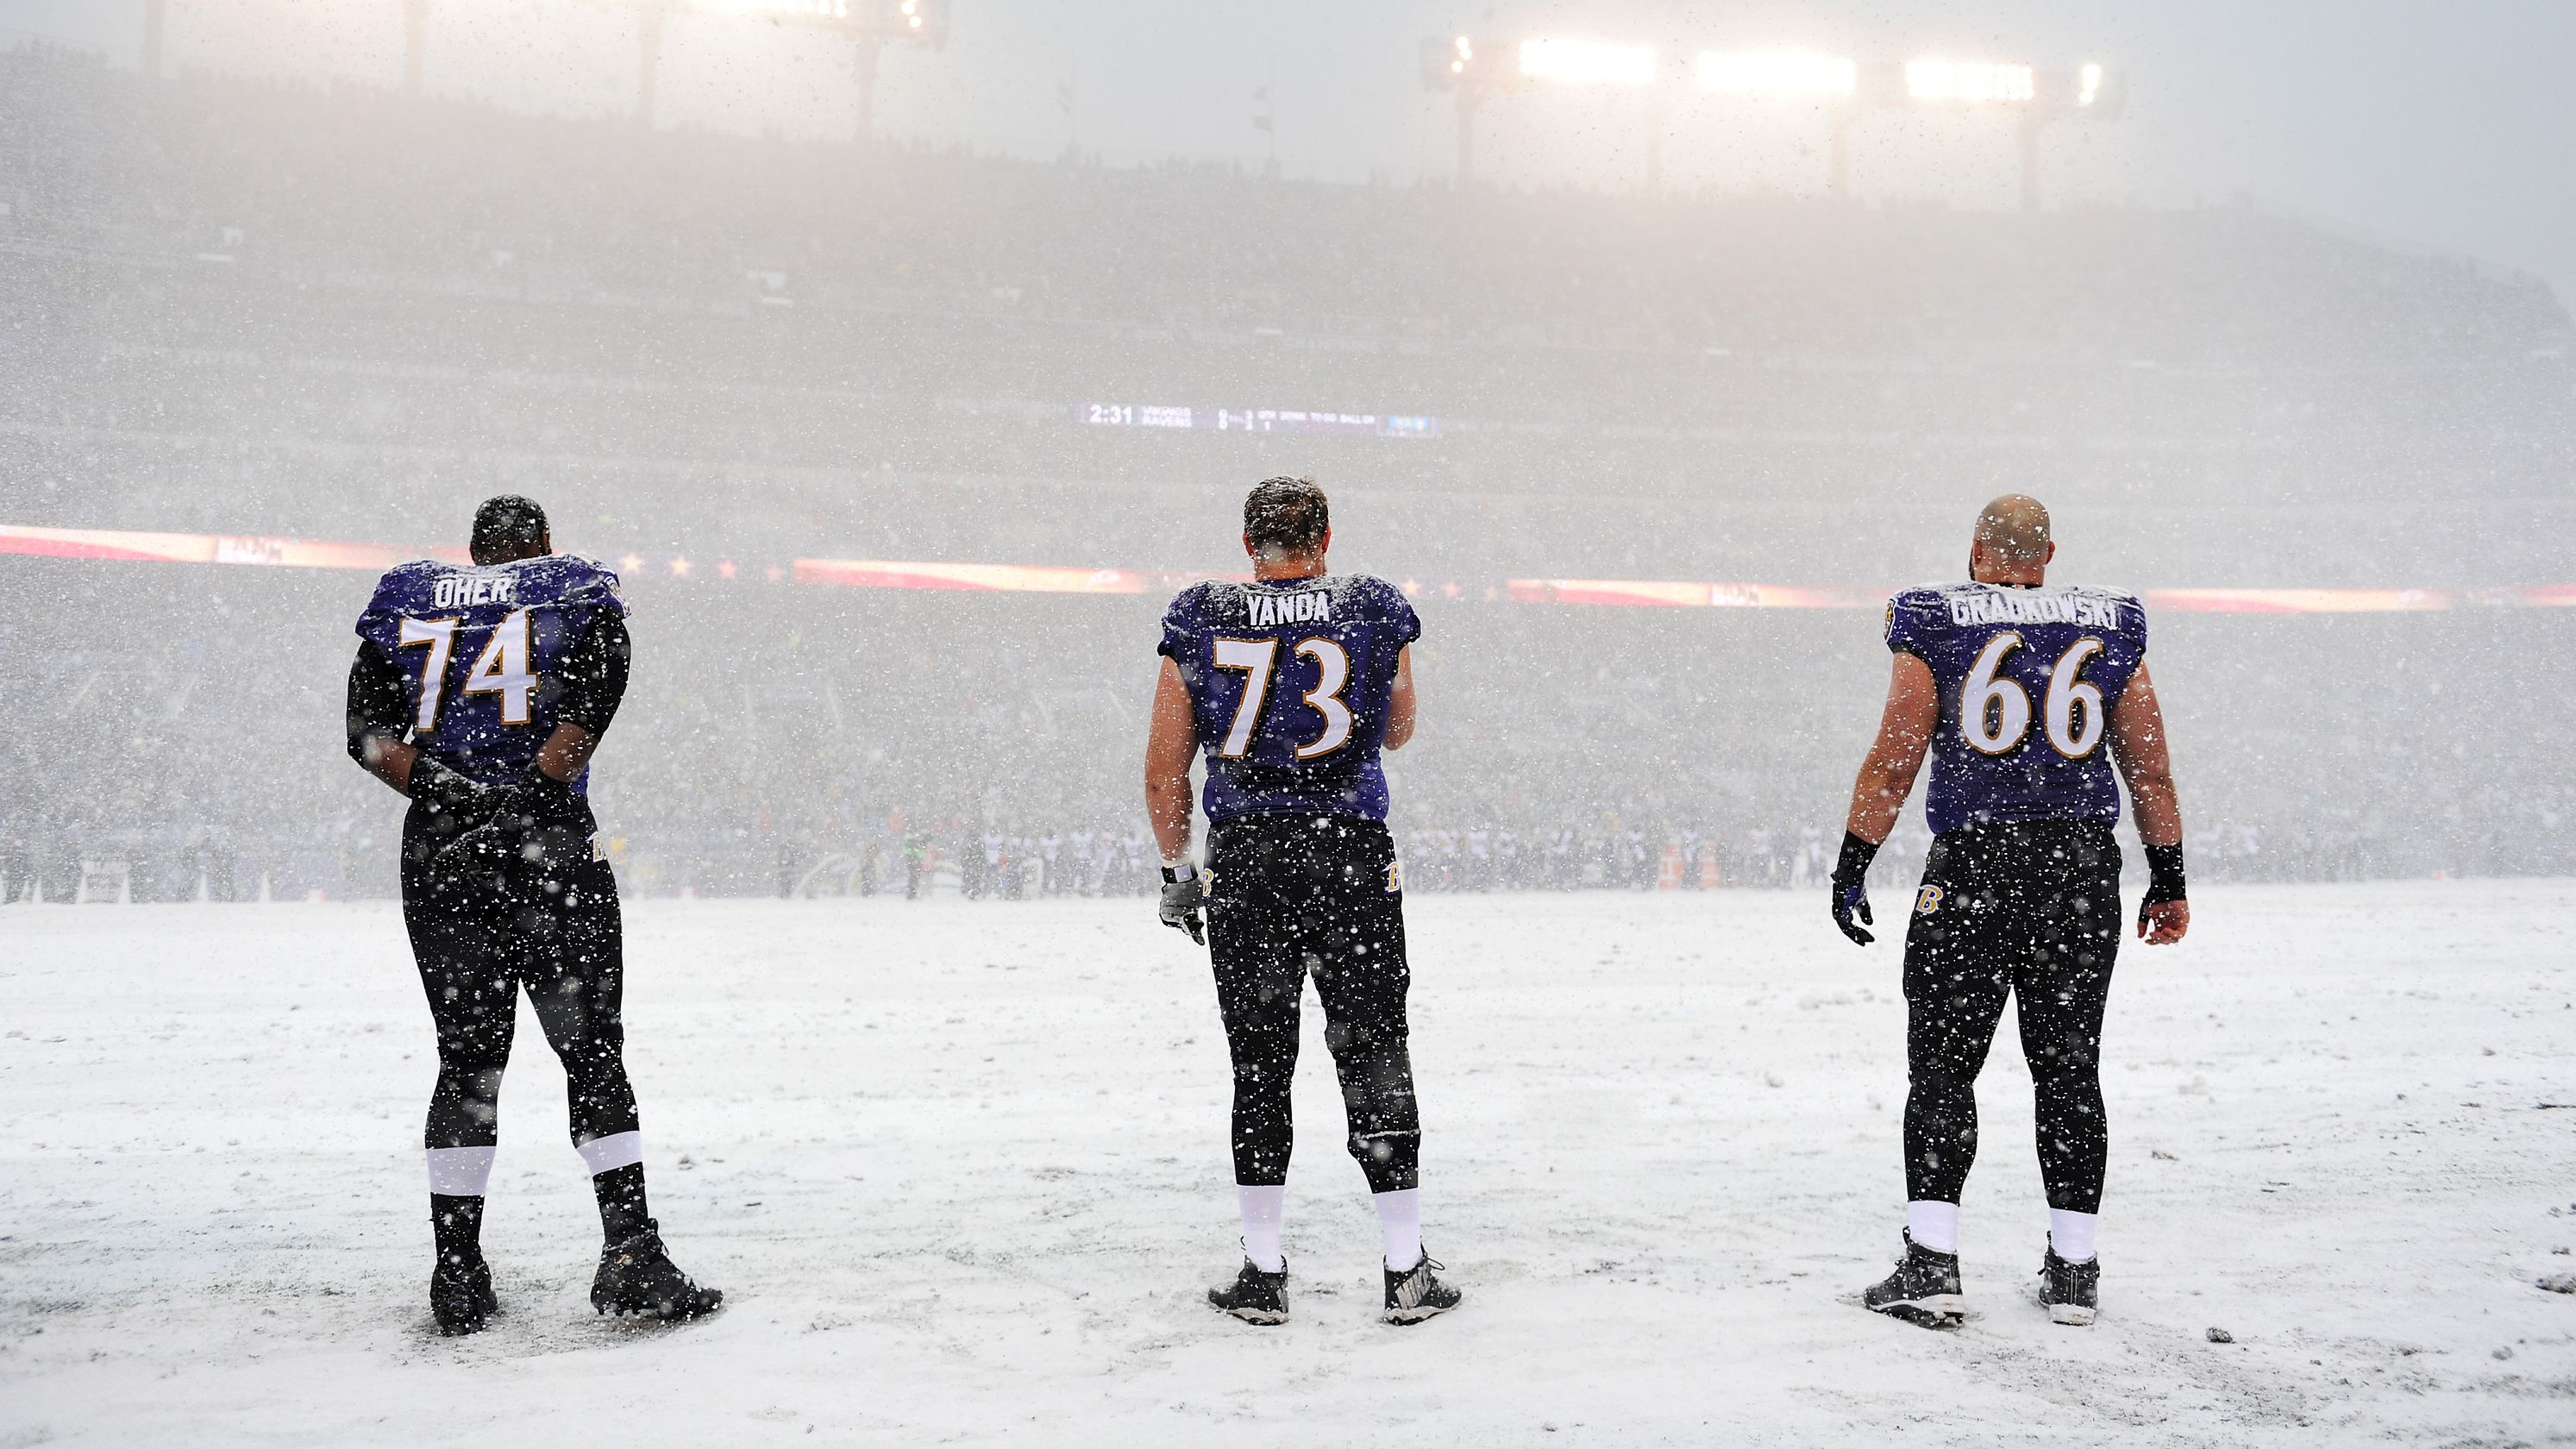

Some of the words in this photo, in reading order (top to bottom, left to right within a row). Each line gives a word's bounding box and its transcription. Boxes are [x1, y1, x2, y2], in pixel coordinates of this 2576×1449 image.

[1090, 404, 1132, 425] 2:31
[436, 577, 511, 608] OHER
[1247, 592, 1329, 626] YANDA
[1951, 593, 2118, 629] GRADKOWSKI
[398, 607, 541, 732] 74
[1213, 637, 1354, 760] 73
[1959, 630, 2104, 759] 66
[1915, 884, 1944, 914] B
